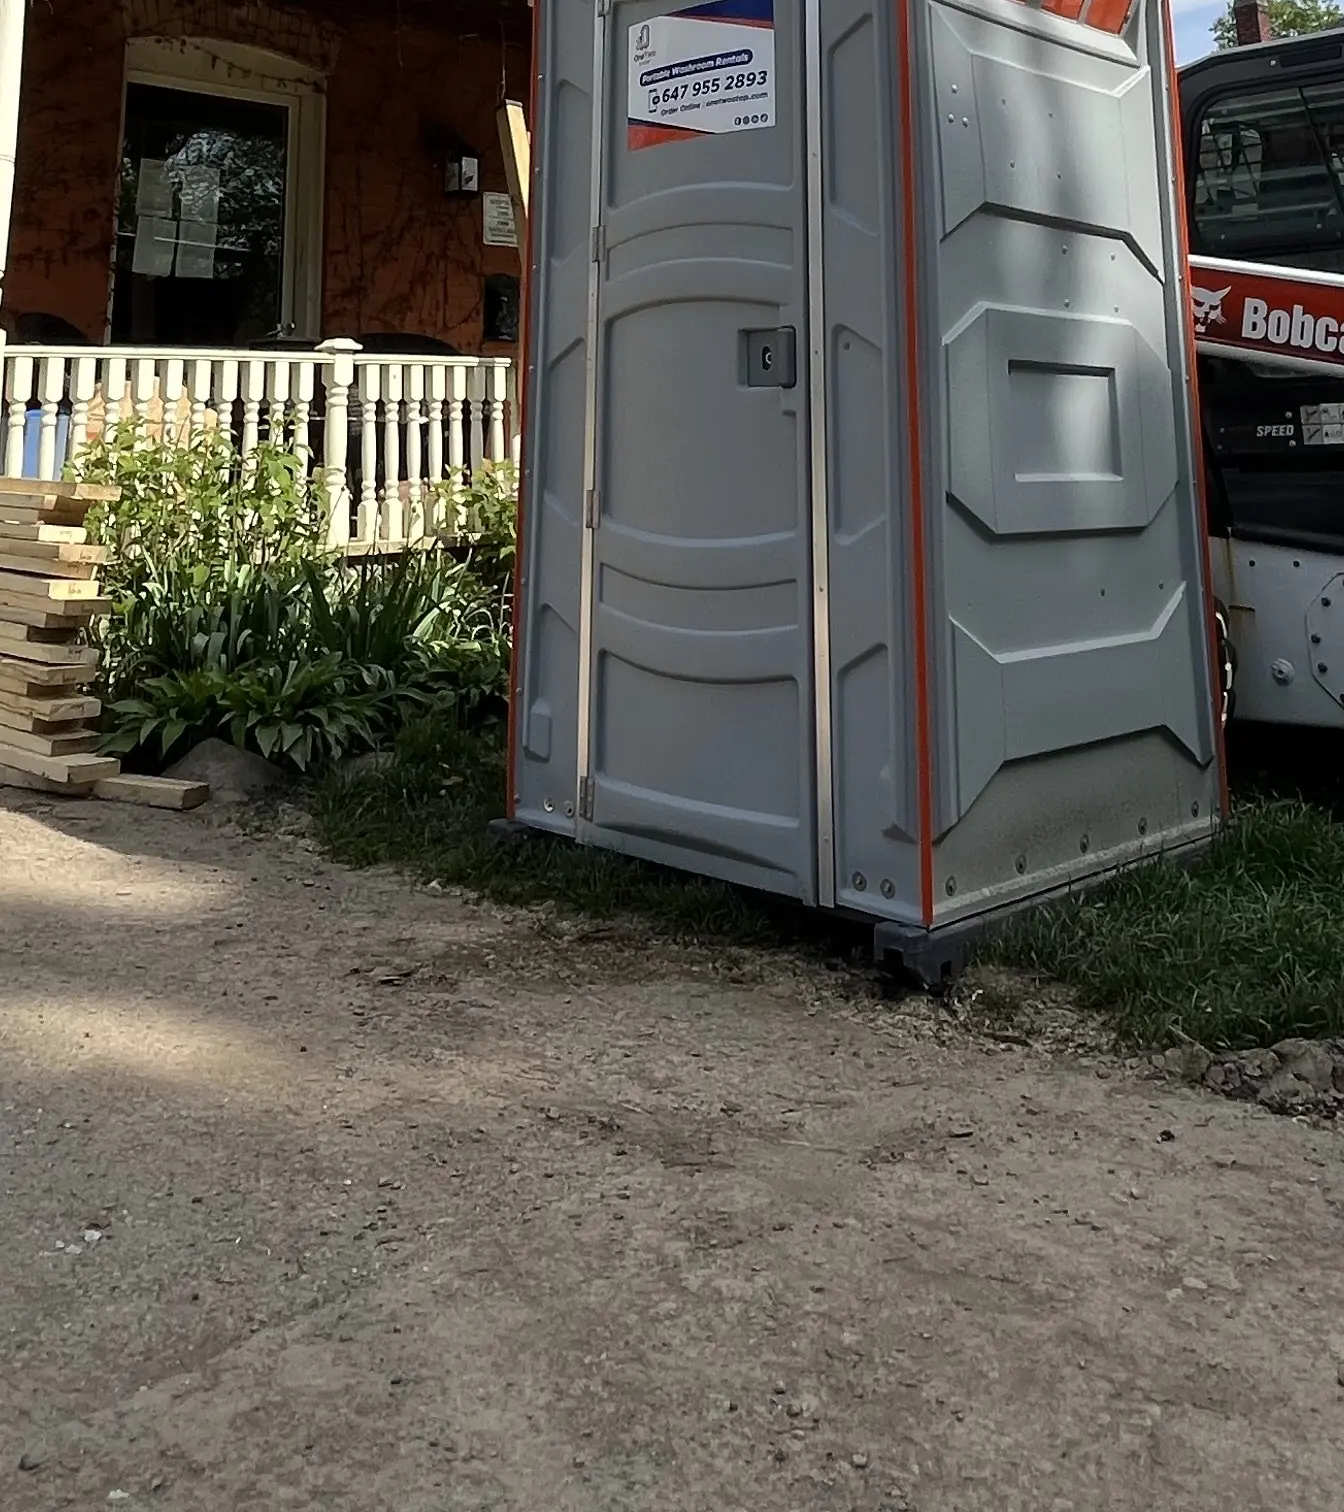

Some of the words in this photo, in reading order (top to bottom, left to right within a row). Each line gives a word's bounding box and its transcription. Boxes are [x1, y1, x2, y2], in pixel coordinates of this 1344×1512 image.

[671, 60, 714, 76] Washroom
[716, 53, 749, 66] Rentals
[662, 84, 689, 103] 647
[692, 78, 721, 97] 955
[724, 70, 768, 90] 2893
[1257, 424, 1294, 437] SPEED
